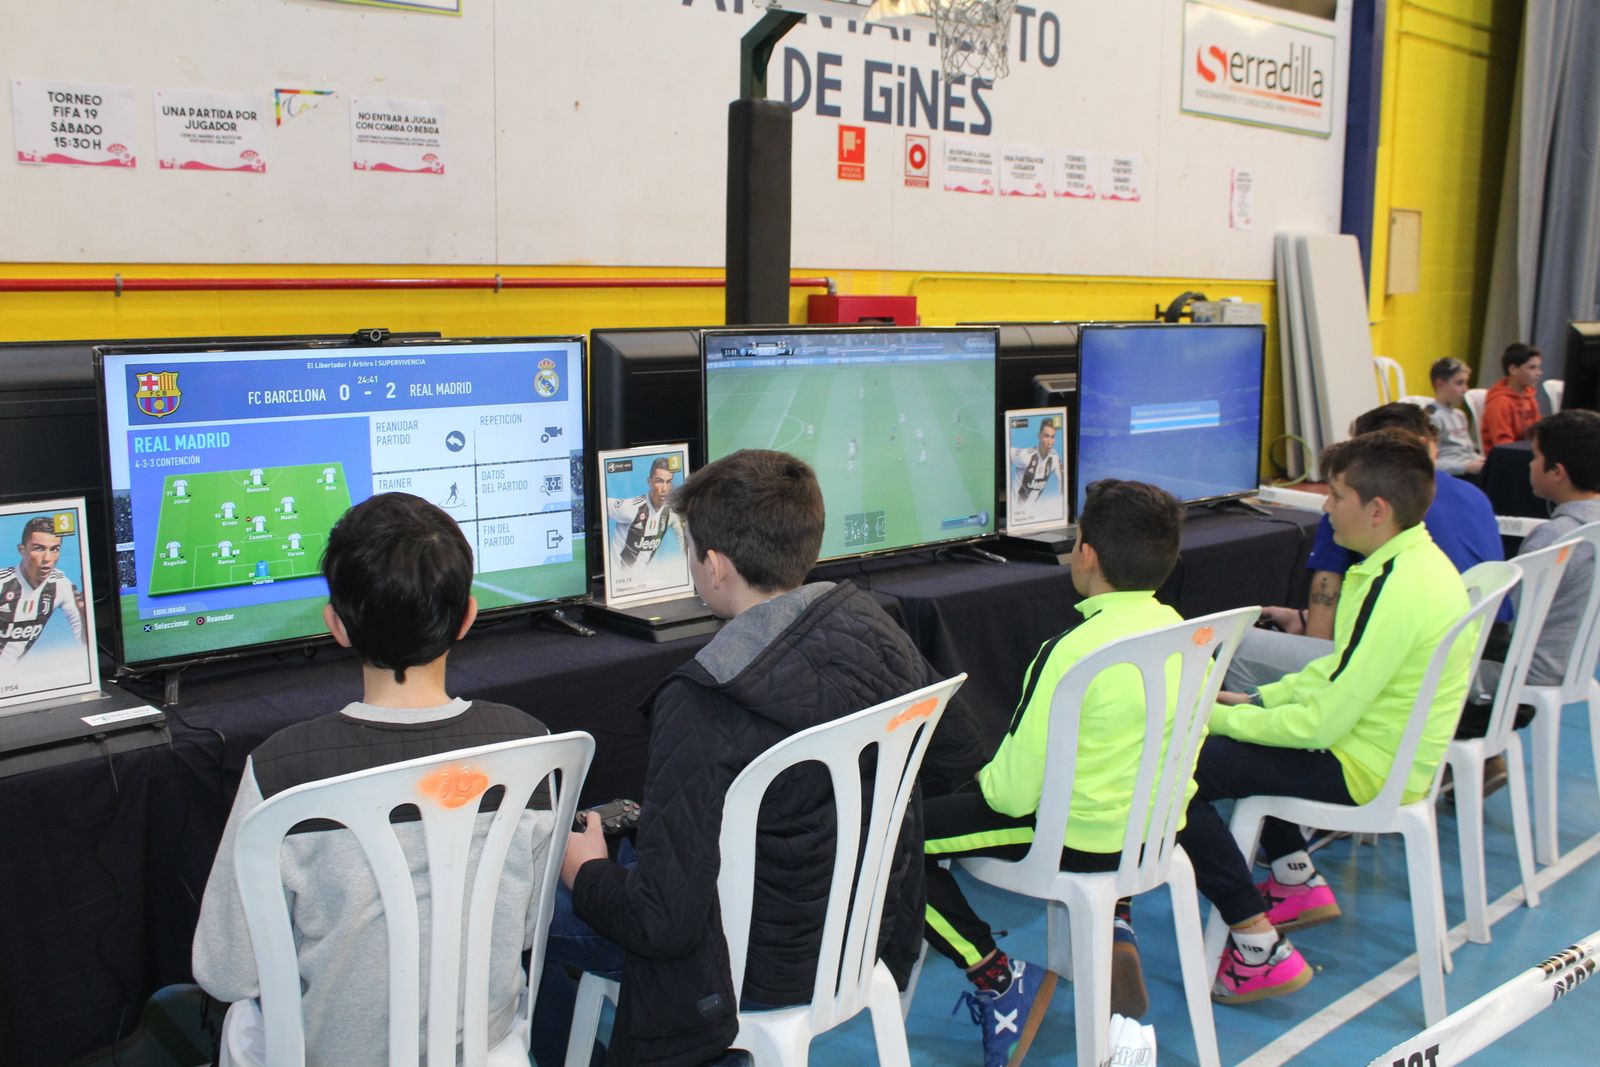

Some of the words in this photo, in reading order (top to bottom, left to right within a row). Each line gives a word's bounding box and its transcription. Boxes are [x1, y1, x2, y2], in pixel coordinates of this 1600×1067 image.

[1196, 42, 1324, 99] Serradilla
[784, 46, 843, 118] DE
[47, 91, 102, 106] TORNEO
[53, 106, 81, 118] FIFA
[84, 109, 98, 119] 19
[162, 106, 186, 117] UNA
[189, 107, 234, 120] PARTIDA
[235, 110, 257, 121] POR
[358, 112, 371, 121] NO
[372, 113, 402, 123] ENTRAR
[411, 115, 437, 125] JUGAR
[50, 119, 103, 135] SÁBADO
[185, 119, 237, 132] JUGADOR
[355, 121, 374, 130] CON
[375, 122, 405, 132] COMIDA
[406, 125, 413, 133] O
[414, 125, 440, 134] BEBIDA
[54, 136, 91, 149] 15:30
[315, 360, 347, 369] Libertador
[352, 358, 374, 368] Árbitro
[378, 358, 426, 367] SUPERVIVENCIA
[357, 376, 378, 384] 24:41
[248, 391, 262, 405] FC
[264, 388, 327, 404] BARCELONA
[339, 384, 350, 401] 0
[386, 382, 396, 399] 2
[410, 384, 434, 397] REAL
[436, 381, 473, 395] MADRID
[376, 419, 419, 432] REANUDAR
[480, 412, 523, 426] REPETICIÓN
[134, 434, 171, 454] REAL
[175, 431, 231, 451] MADRID
[376, 434, 411, 446] PARTIDO
[135, 459, 155, 469] 4-3-3
[156, 454, 201, 467] CONTENCIÓN
[671, 456, 680, 468] 3
[481, 469, 506, 481] DATOS
[378, 477, 412, 490] TRAINER
[482, 482, 496, 494] DEL
[497, 480, 528, 492] PARTIDO
[59, 514, 69, 531] 3
[483, 524, 496, 535] FIN
[497, 522, 511, 534] DEL
[484, 535, 515, 548] PARTIDO
[634, 536, 662, 550] Jeep
[153, 605, 187, 616] EQUILIBRADA
[154, 619, 189, 631] Seleccionar
[206, 612, 235, 624] Reanudar
[0, 622, 44, 640] Jeep
[5, 684, 19, 692] PS4
